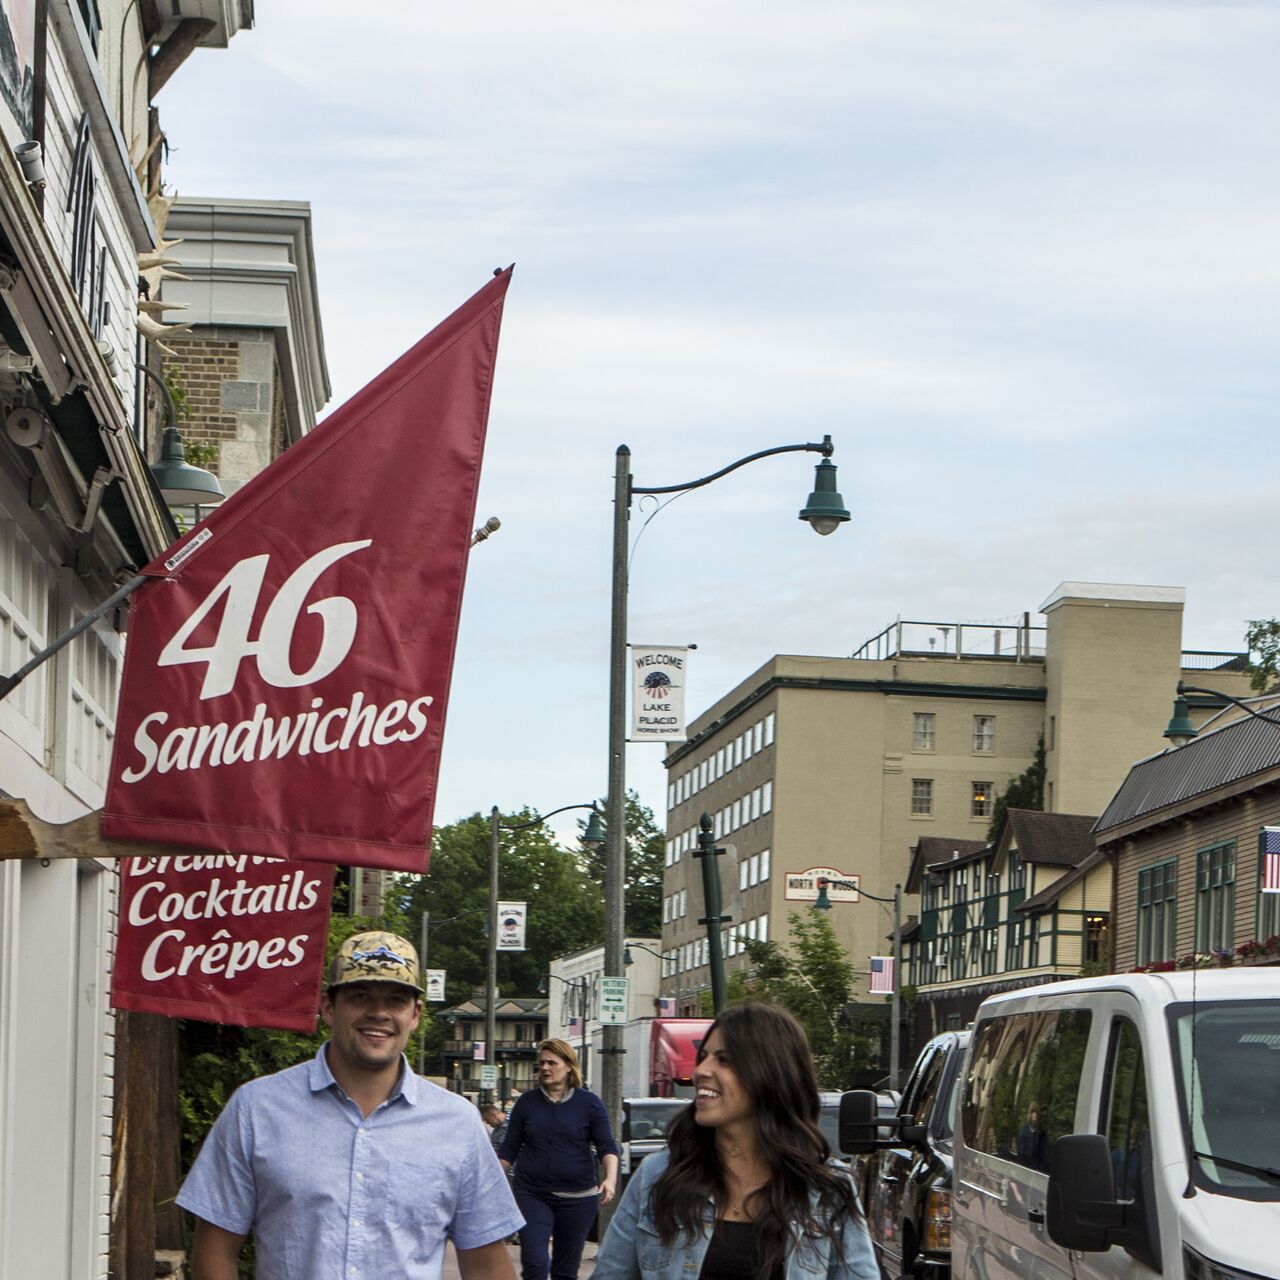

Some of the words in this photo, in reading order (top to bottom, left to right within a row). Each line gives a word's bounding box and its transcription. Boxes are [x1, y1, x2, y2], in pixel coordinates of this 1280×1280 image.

[157, 539, 373, 701] 46
[635, 654, 683, 670] WELCOME
[639, 716, 677, 725] PLACID
[643, 703, 672, 711] LAKE
[121, 691, 433, 783] Sandwiches
[128, 870, 321, 927] Cocktails
[141, 929, 309, 982] Crêpes
